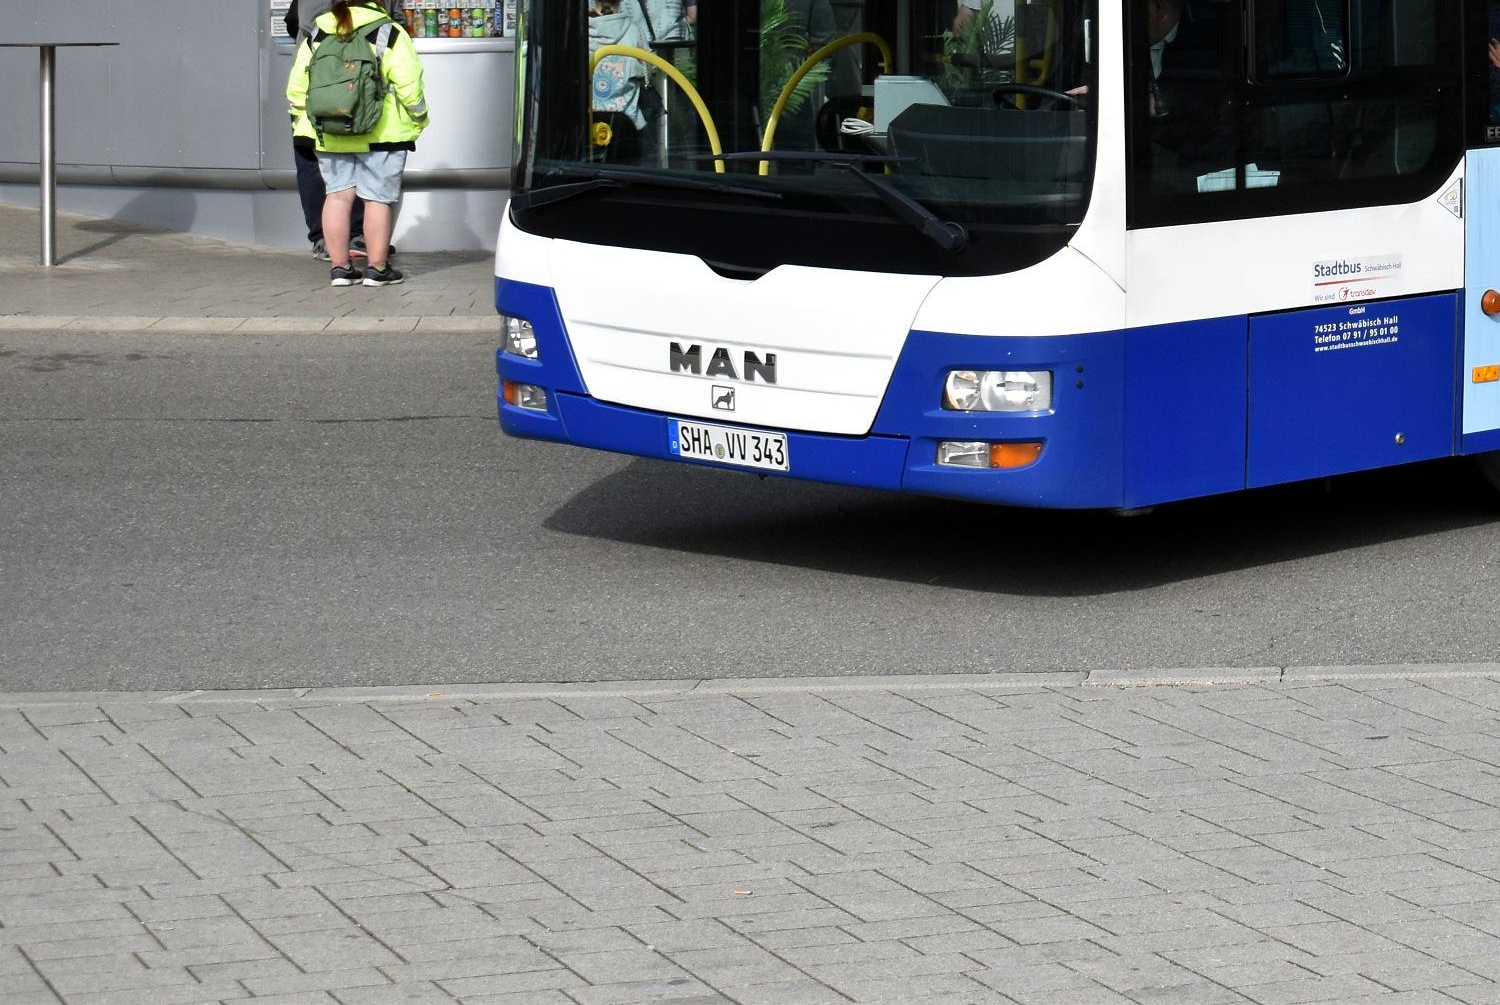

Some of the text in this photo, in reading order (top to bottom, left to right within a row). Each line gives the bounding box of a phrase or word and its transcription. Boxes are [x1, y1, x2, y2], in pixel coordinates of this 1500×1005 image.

[1314, 260, 1362, 278] Stadtbus
[1364, 263, 1392, 273] Schwäbisch
[1350, 288, 1376, 297] transdev
[1314, 315, 1398, 334] 74523 Schwäbisch Hall
[1314, 332, 1341, 344] Telefon
[1343, 332, 1351, 340] 07
[1353, 330, 1361, 338] 91
[1370, 328, 1378, 336] 95
[1380, 327, 1388, 335] 01
[1390, 326, 1398, 334] 00
[669, 341, 778, 385] MAN
[680, 426, 713, 456] SHA
[725, 432, 747, 461] VV
[751, 435, 785, 466] 343
